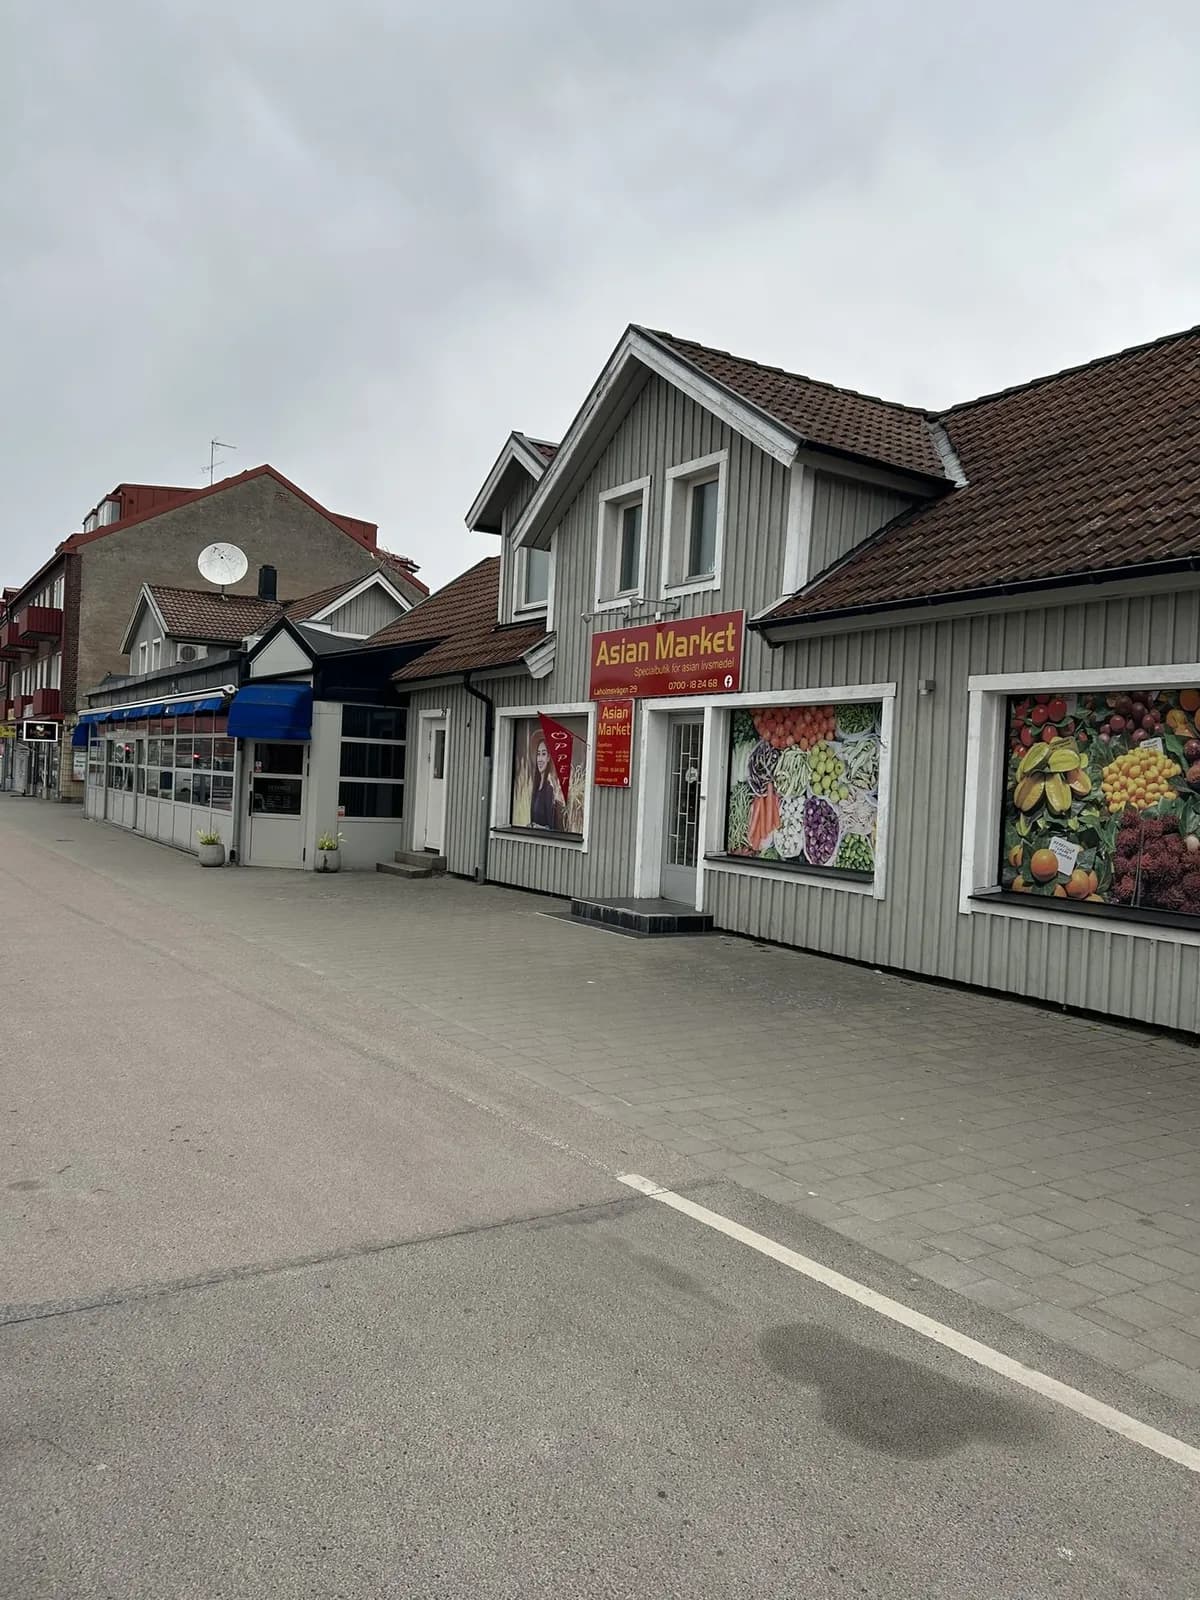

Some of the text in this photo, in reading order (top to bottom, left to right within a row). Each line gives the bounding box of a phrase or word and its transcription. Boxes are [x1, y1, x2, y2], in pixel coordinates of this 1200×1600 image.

[595, 622, 736, 666] Asian Market
[682, 662, 700, 672] asian
[698, 679, 707, 688] 24
[707, 678, 718, 688] 68
[629, 685, 638, 694] 29
[601, 706, 629, 720] Asian
[597, 722, 631, 736] Market
